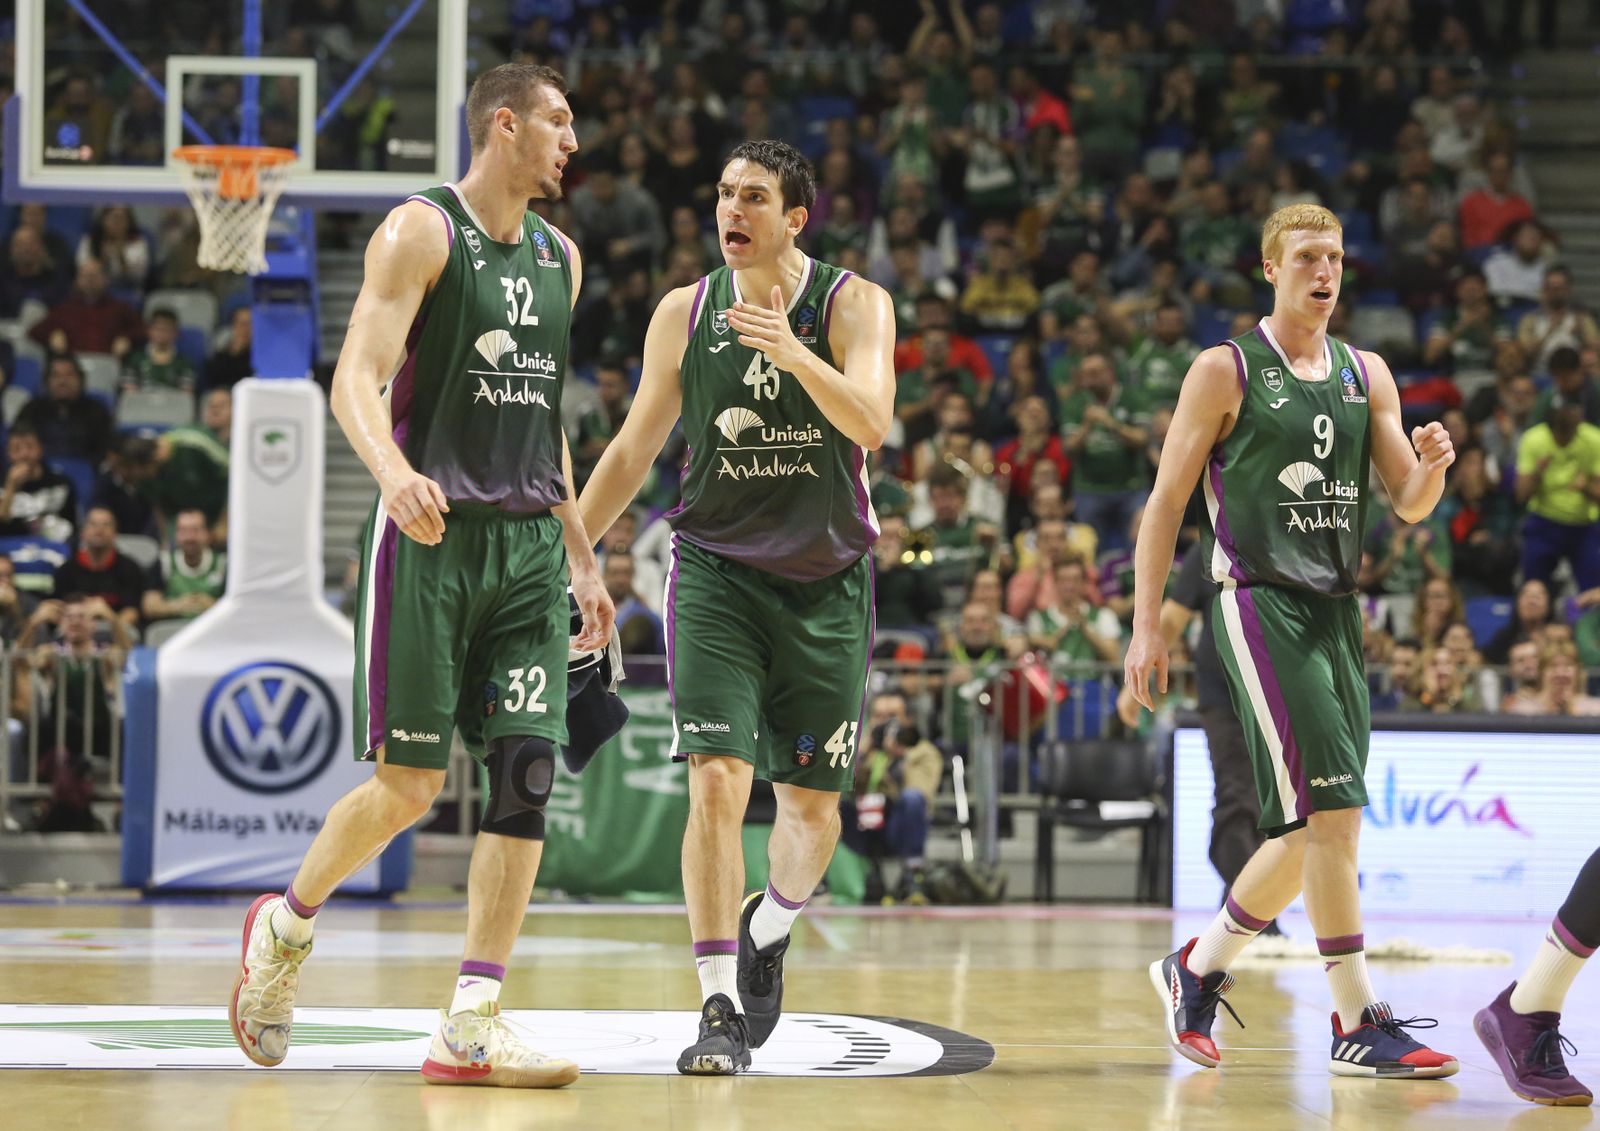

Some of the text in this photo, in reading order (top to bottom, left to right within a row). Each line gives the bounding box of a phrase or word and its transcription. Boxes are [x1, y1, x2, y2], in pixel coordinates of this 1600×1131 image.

[500, 277, 539, 326] 32
[513, 352, 557, 374] Unicja
[742, 351, 780, 400] 43
[761, 423, 823, 443] Unicaja
[1313, 413, 1335, 460] 9
[716, 452, 820, 481] Andalucía
[1322, 479, 1359, 501] Uicaja
[1285, 505, 1352, 534] Andalía
[504, 665, 548, 714] 32
[700, 721, 731, 730] MÁLAGA
[823, 719, 859, 769] 43
[163, 809, 325, 839] Málaga Wa
